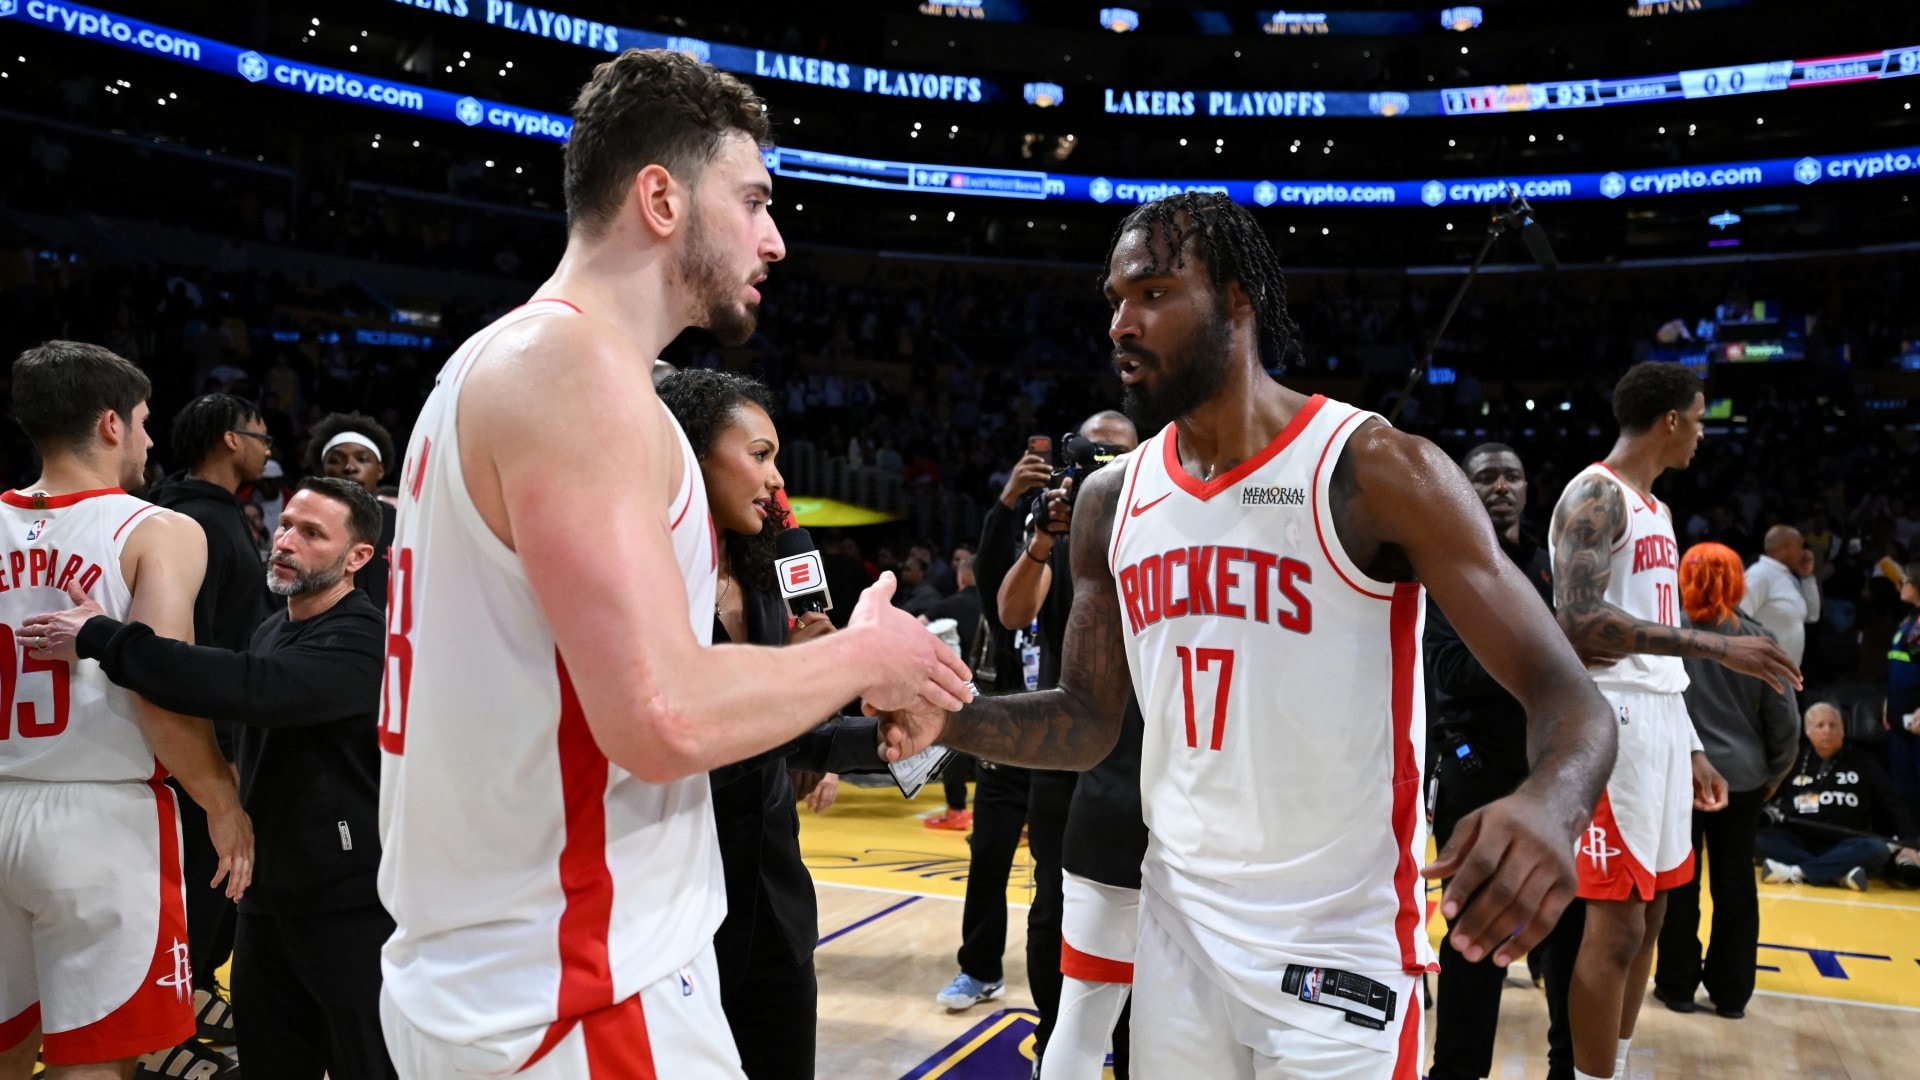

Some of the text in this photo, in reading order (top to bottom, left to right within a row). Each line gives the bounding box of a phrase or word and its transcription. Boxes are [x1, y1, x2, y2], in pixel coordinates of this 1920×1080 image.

[27, 0, 201, 61] crypto.com
[486, 0, 619, 52] PLAYOFFS
[756, 50, 850, 89] LAKERS
[863, 67, 982, 103] PLAYOFFS
[1802, 61, 1869, 81] Rockets
[274, 64, 424, 110] crypto.com
[1556, 84, 1586, 106] 93
[1616, 82, 1667, 99] Lakers
[1104, 88, 1327, 117] LAKERS PLAYOFFS
[1280, 183, 1396, 205] crypto.com
[1449, 179, 1572, 203] crypto.com
[1629, 165, 1762, 194] crypto.com
[1242, 495, 1305, 505] HERMANN
[1243, 487, 1305, 497] MEMORIAL
[1119, 544, 1313, 637] ROCKETS
[1176, 645, 1235, 752] 17
[1835, 770, 1859, 785] 20
